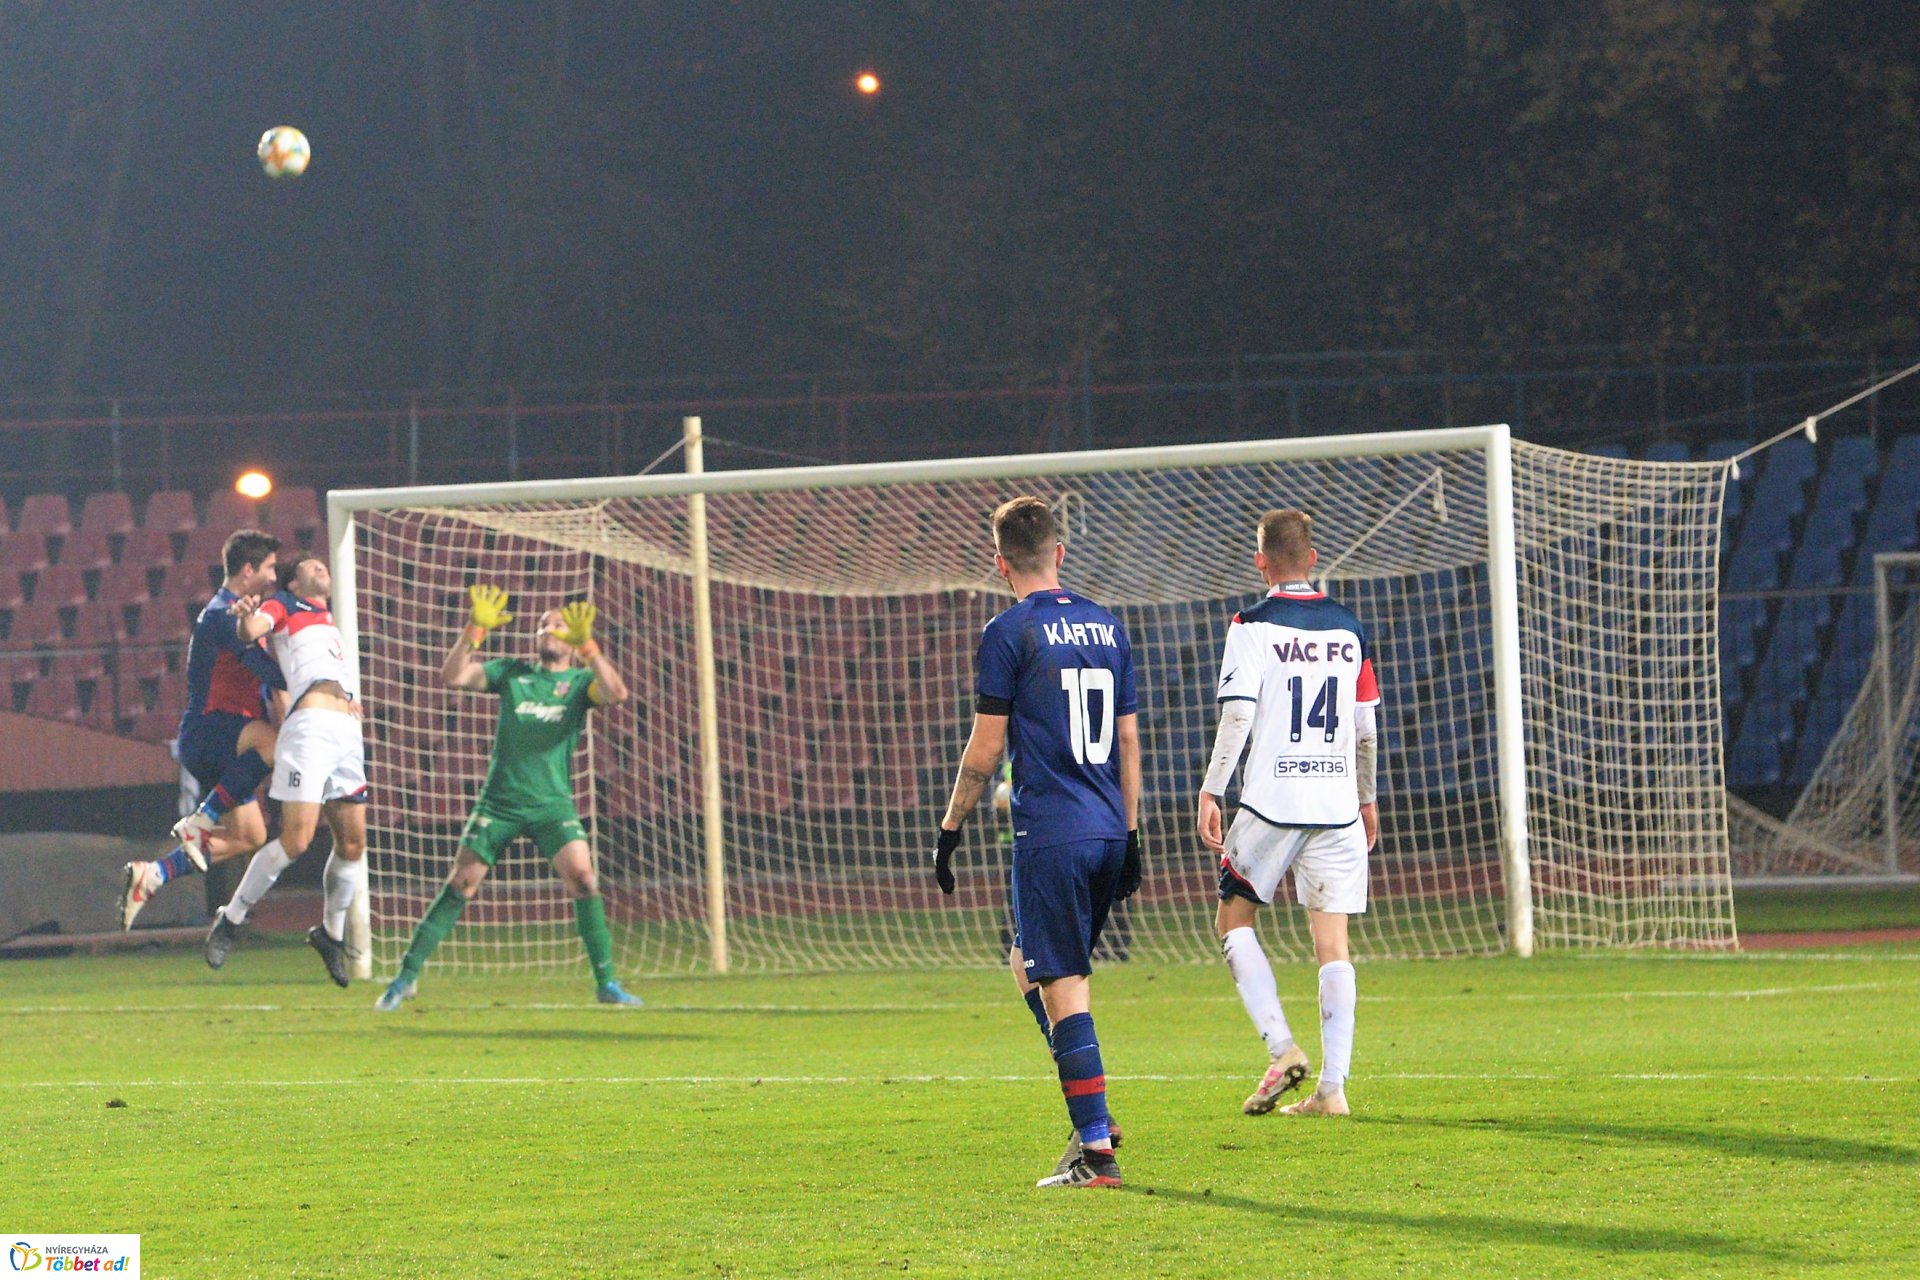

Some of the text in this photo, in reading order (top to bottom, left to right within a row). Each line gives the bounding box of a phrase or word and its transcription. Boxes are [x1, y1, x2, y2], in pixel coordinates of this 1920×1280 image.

[1272, 637, 1354, 663] VÁC FC
[1060, 668, 1114, 764] 10
[1288, 676, 1339, 743] 14
[288, 771, 301, 788] 16
[1278, 761, 1344, 773] SPORT36
